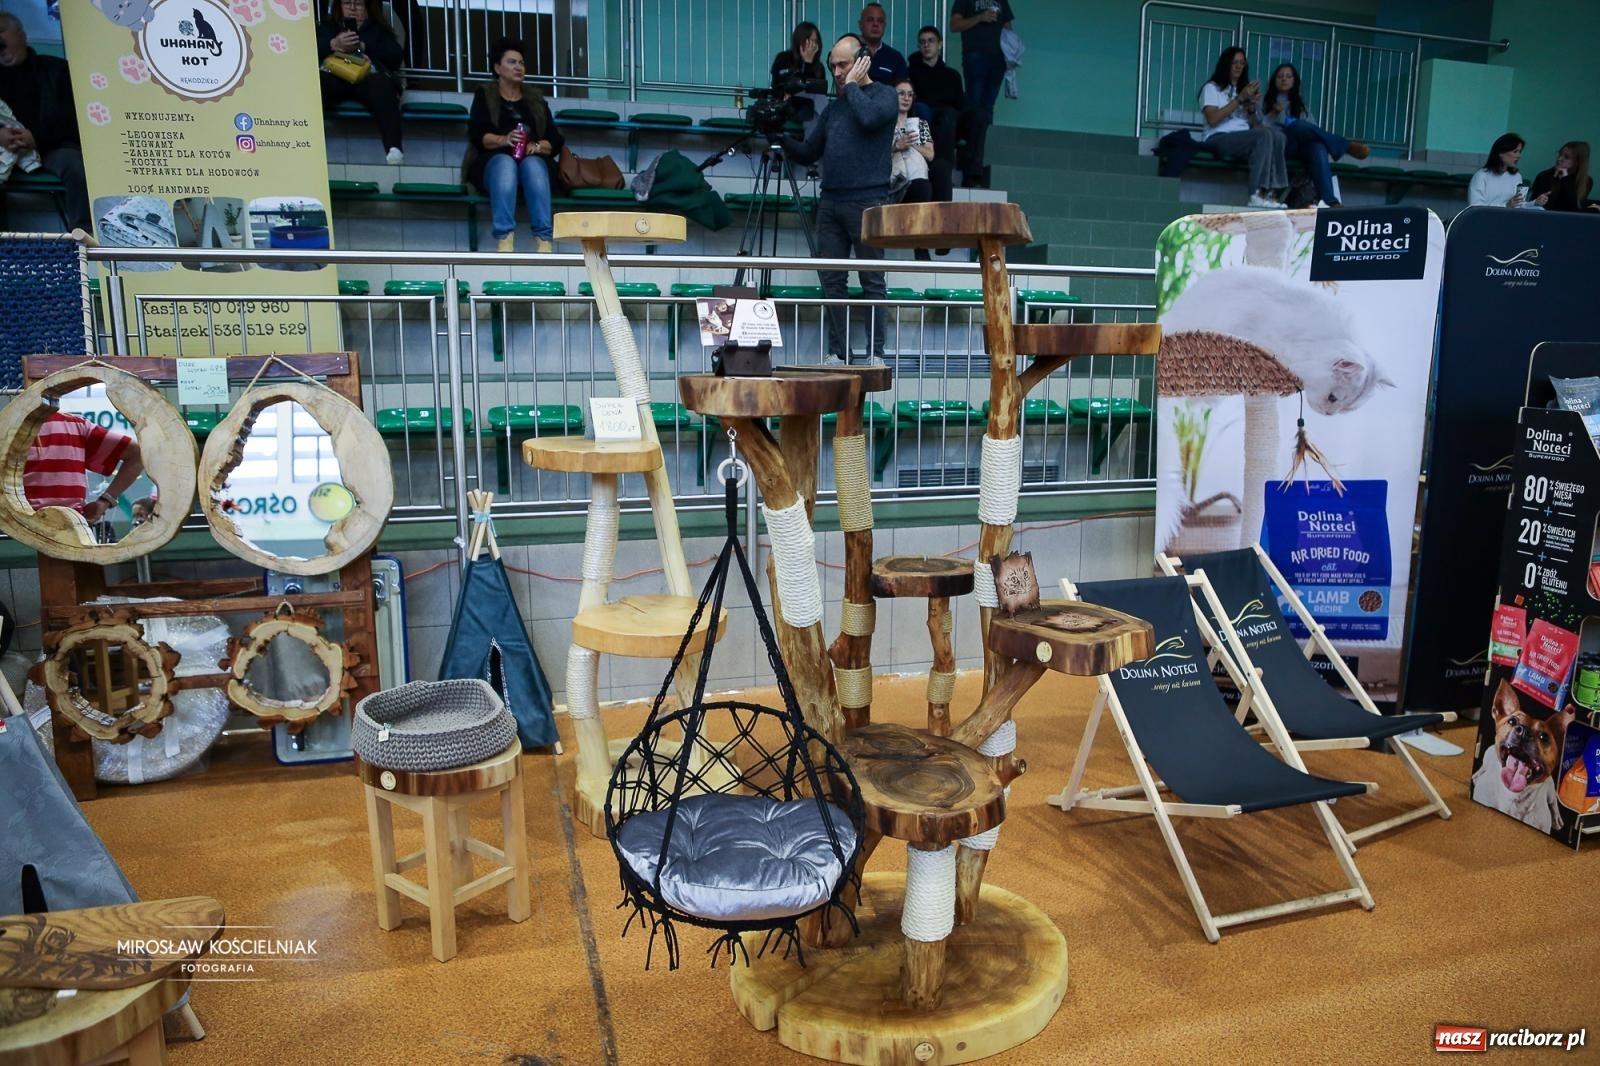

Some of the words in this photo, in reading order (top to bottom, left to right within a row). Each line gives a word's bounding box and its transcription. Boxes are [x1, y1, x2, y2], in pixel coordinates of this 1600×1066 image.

[160, 38, 223, 56] UHAHANY
[182, 56, 208, 66] KOT
[124, 112, 195, 122] WYKONUJEMY:
[254, 118, 290, 128] Uhahany
[292, 119, 308, 127] kot
[256, 140, 311, 150] uhahany_kot
[177, 150, 196, 158] DLA
[200, 149, 231, 159] KOTÓW
[186, 168, 204, 176] DLA
[208, 168, 260, 177] HODOWCÓW
[128, 184, 154, 194] 100%
[158, 186, 210, 194] HANDMADE
[1327, 220, 1393, 237] Dolina
[1341, 234, 1410, 252] Noteci
[1486, 266, 1512, 276] DOLINA
[1514, 268, 1540, 277] NOTECI
[143, 302, 188, 314] Kasia
[261, 301, 290, 313] 960
[145, 324, 210, 338] Staszek
[214, 324, 242, 336] 536
[247, 322, 274, 336] 519
[280, 322, 306, 336] 529
[1526, 428, 1563, 442] Dolina
[1533, 440, 1572, 454] Noteci
[1298, 511, 1342, 522] Dolina
[1309, 520, 1356, 532] Noteci
[1291, 549, 1309, 564] AIR
[1310, 547, 1340, 560] DRIED
[1343, 548, 1370, 564] FOOD
[1542, 577, 1568, 590] GLUTENU
[1308, 590, 1350, 604] LAMB
[1314, 605, 1344, 613] RECIPE
[1218, 628, 1249, 642] DNA
[1249, 620, 1278, 636] NOTECI
[1120, 667, 1159, 680] DOLINA
[1161, 663, 1198, 678] NOTECI
